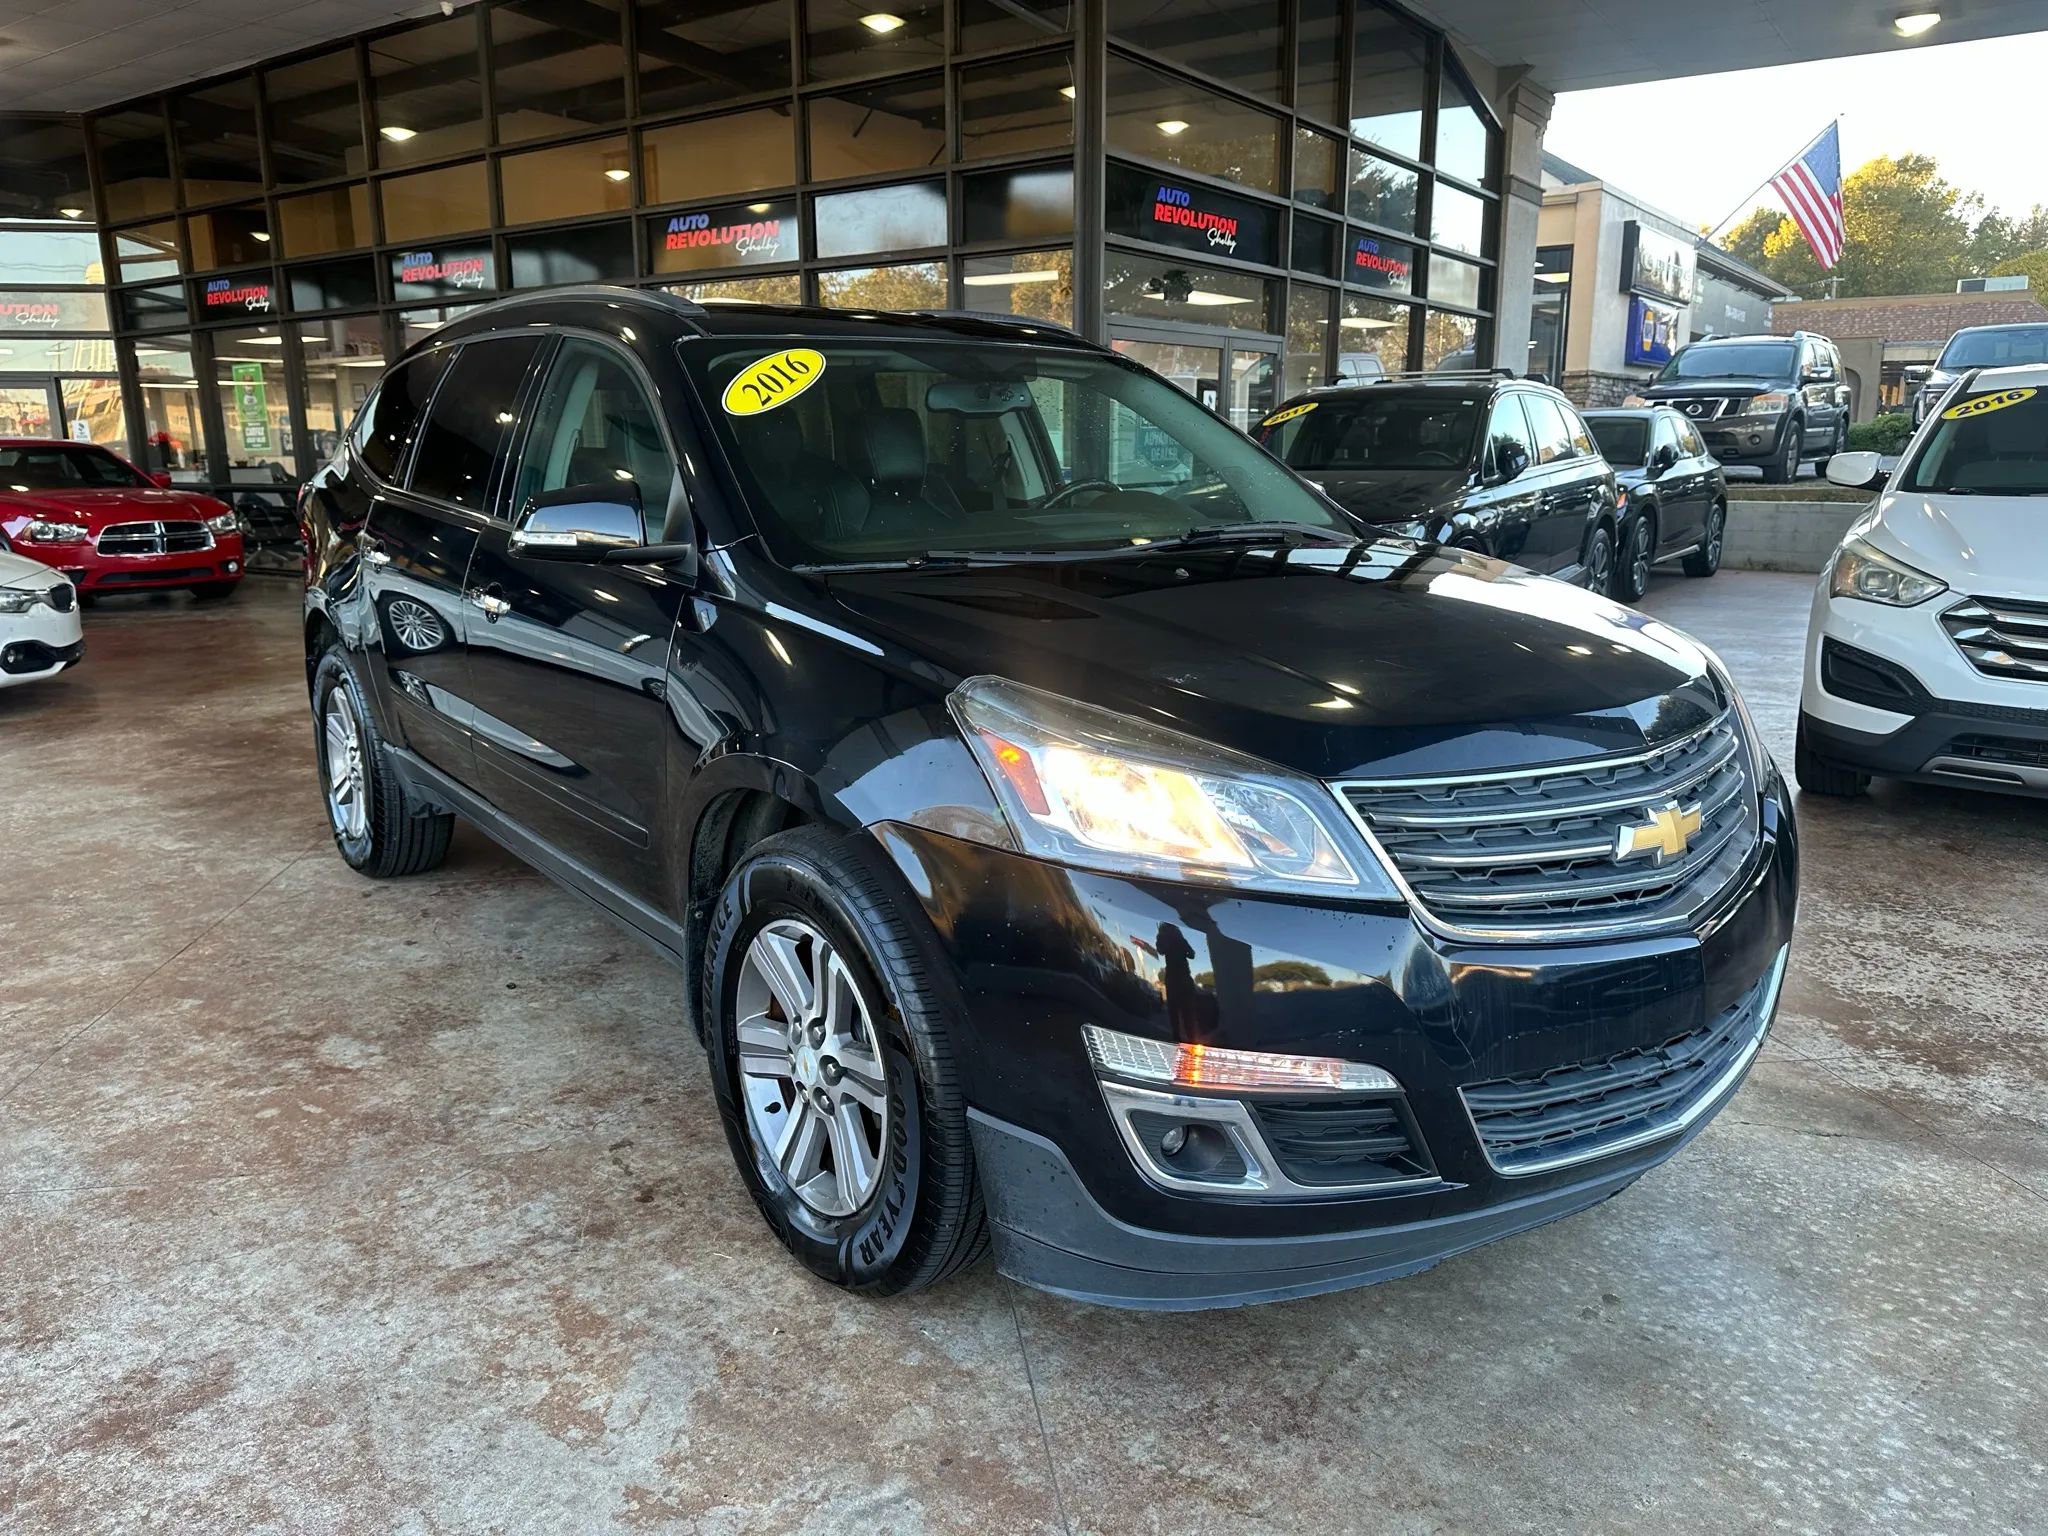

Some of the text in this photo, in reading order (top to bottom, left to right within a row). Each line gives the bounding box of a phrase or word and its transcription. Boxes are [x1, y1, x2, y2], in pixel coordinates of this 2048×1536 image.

[1157, 186, 1190, 207] AUTO
[668, 214, 709, 232] AUTO
[1154, 203, 1237, 236] REVOLUTION
[666, 220, 779, 250] REVOLUTION
[735, 234, 780, 257] Shelby
[1358, 239, 1379, 254] AUTO
[402, 257, 485, 283] REVOLUTION
[403, 252, 433, 266] AUTO
[1356, 251, 1408, 277] REVOLUTION
[207, 279, 230, 292] AUTO
[207, 285, 269, 305] REVOLUTION
[741, 353, 810, 407] 2016
[1956, 391, 2025, 416] 2016
